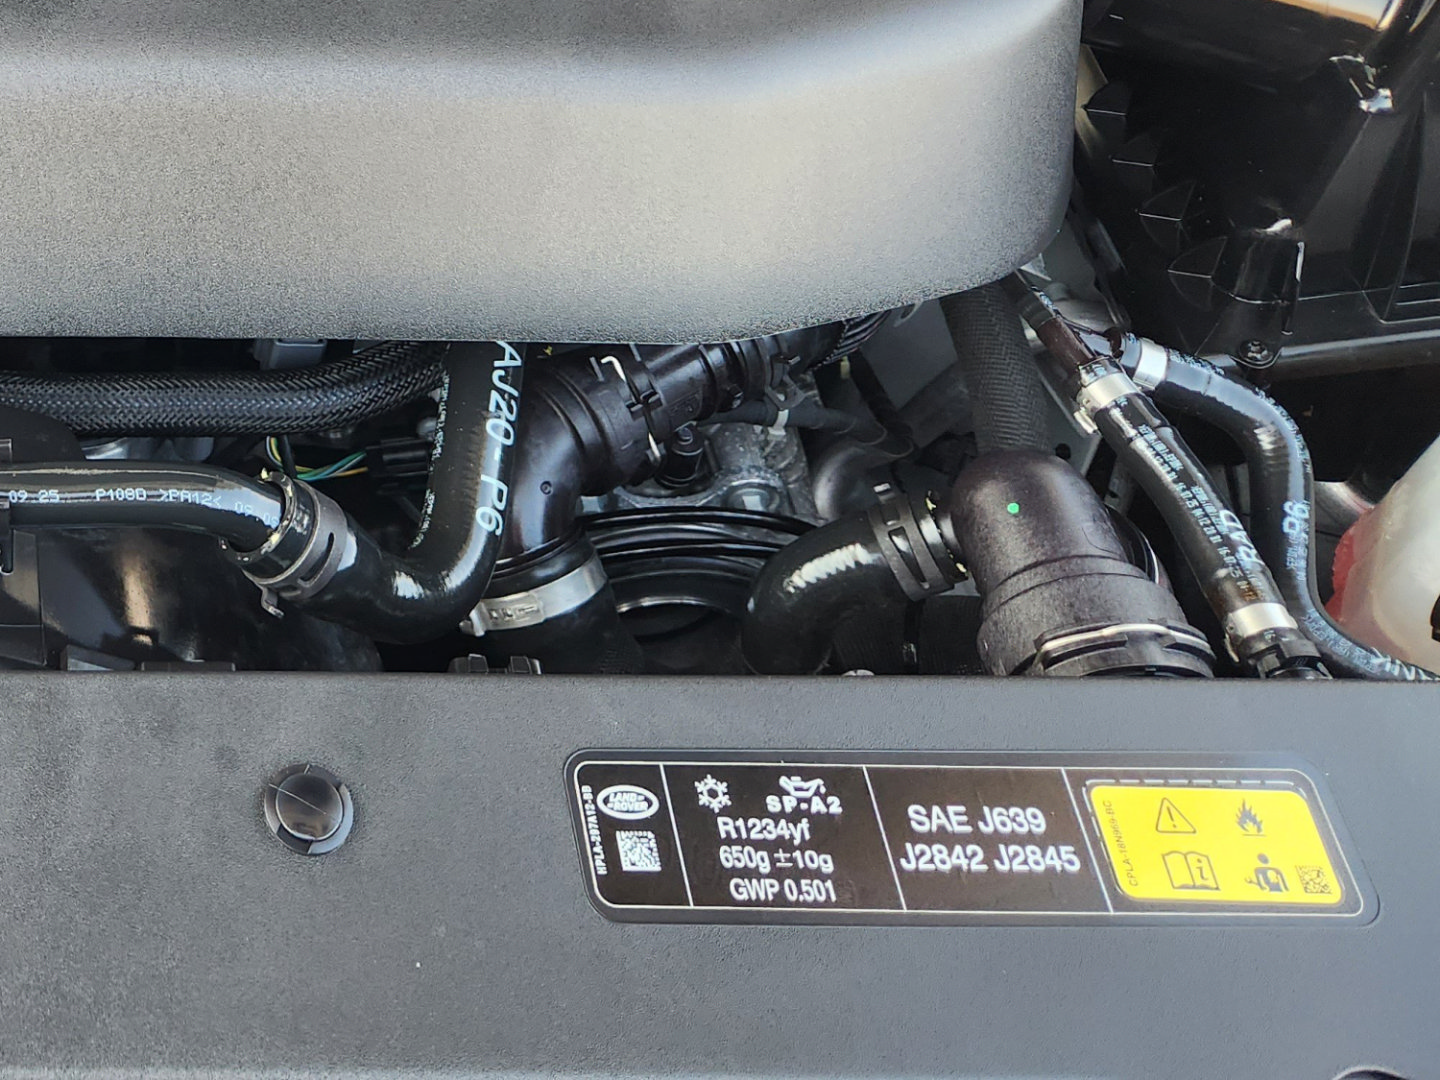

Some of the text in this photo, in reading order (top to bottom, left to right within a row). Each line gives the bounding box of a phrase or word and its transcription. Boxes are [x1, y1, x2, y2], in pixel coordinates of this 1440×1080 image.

[95, 487, 147, 502] P108D
[475, 474, 508, 536] P6
[610, 792, 643, 802] LAND
[613, 801, 649, 812] ROVER
[765, 795, 843, 814] SP-A2
[718, 816, 810, 845] R1234yf
[907, 804, 1047, 834] SAE J639
[719, 846, 771, 874] 650g
[900, 842, 1081, 873] J2842 J2845
[729, 878, 837, 903] GWP 0.501
